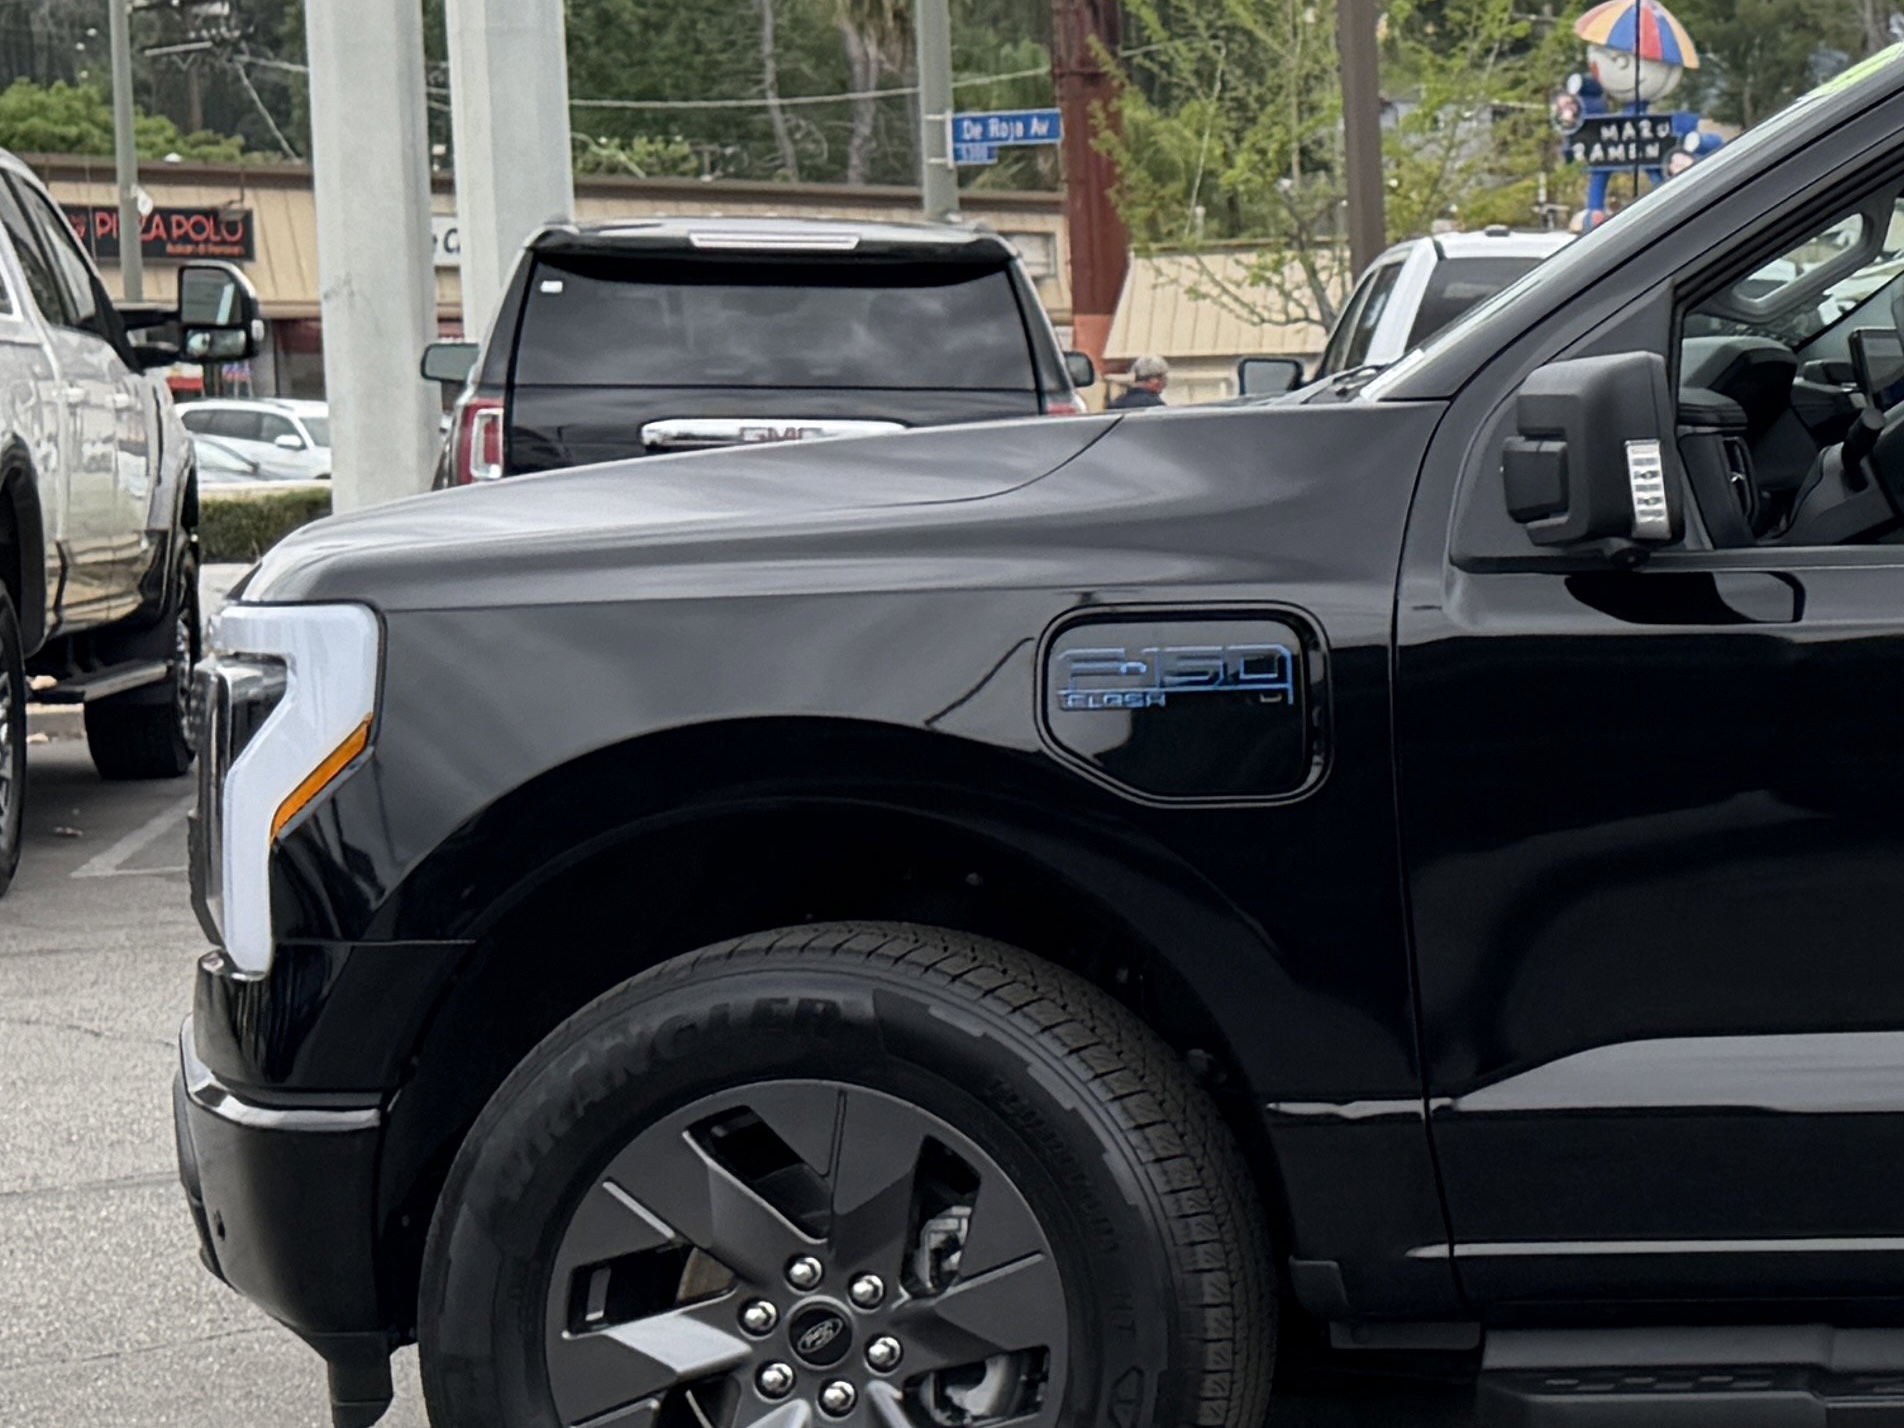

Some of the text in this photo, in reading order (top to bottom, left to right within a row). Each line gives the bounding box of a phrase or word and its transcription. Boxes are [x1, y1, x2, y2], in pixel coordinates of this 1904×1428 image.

[963, 119, 983, 140] De
[1030, 115, 1050, 137] Av
[1601, 119, 1670, 141] MARU
[1573, 142, 1660, 161] RAMEN
[95, 213, 244, 242] PIZA POLO
